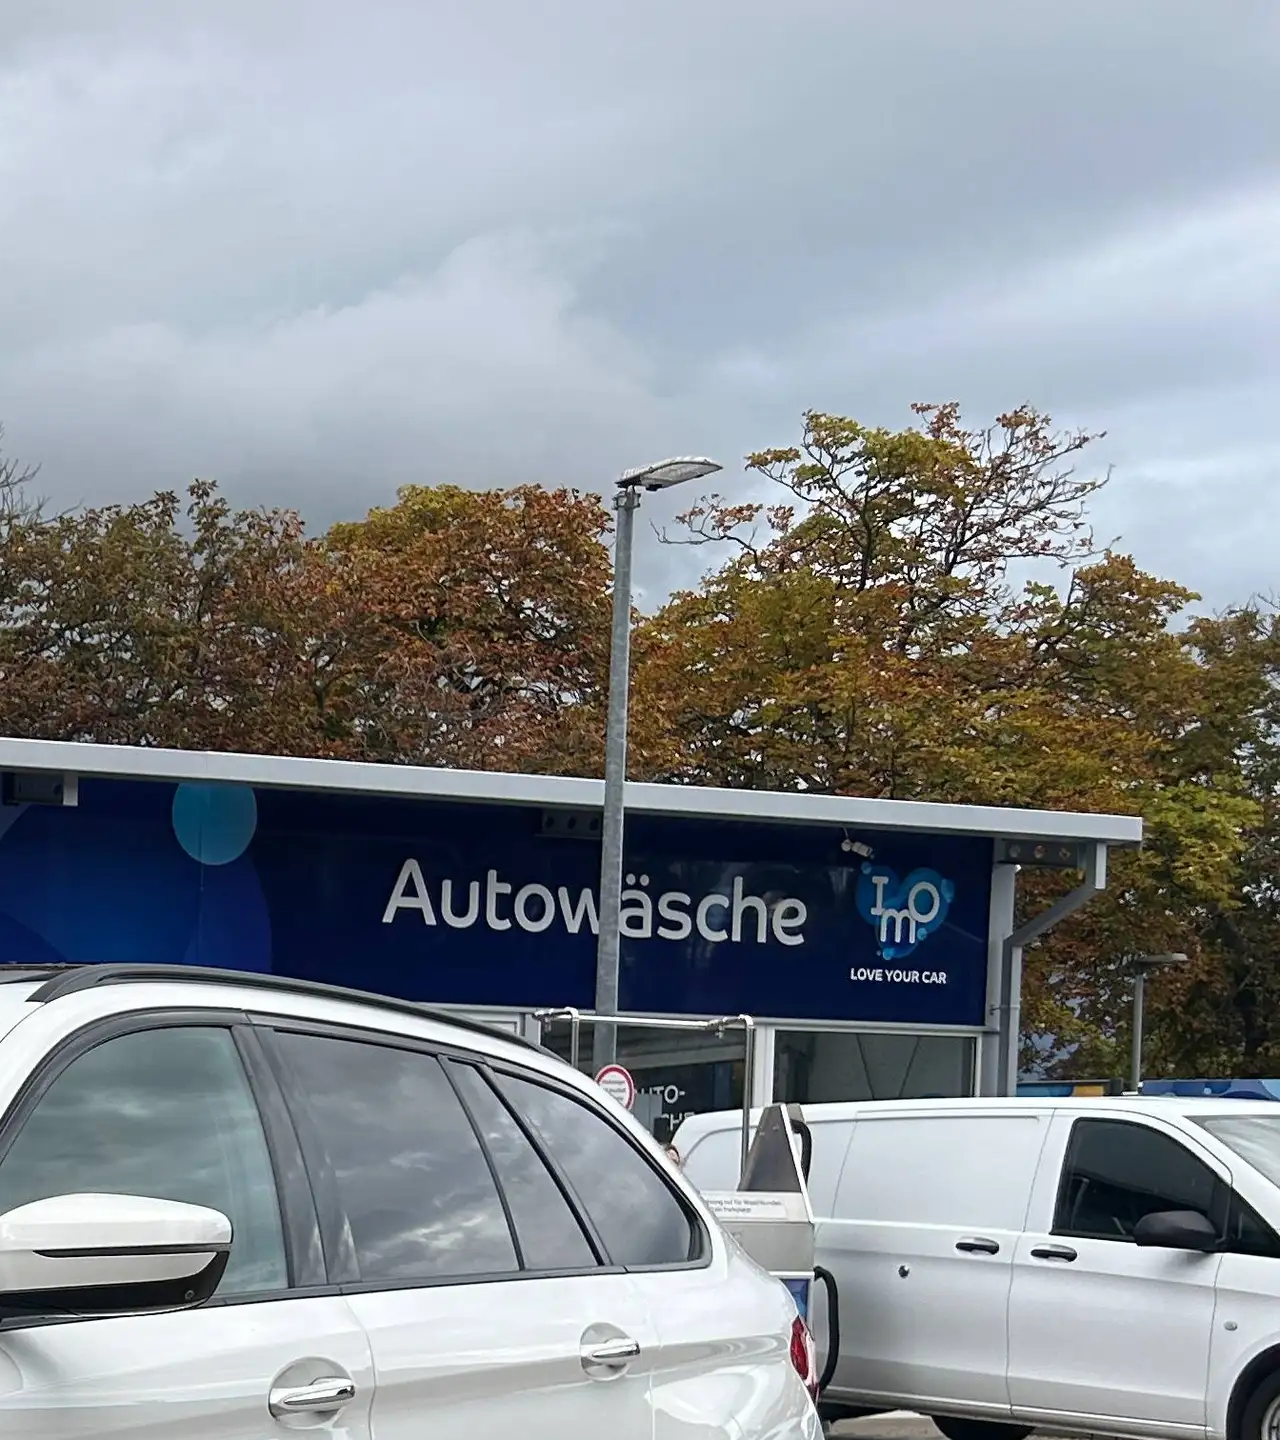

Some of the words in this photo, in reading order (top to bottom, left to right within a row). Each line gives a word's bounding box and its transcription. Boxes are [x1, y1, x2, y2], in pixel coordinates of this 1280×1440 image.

[382, 858, 807, 945] Autowäsche
[850, 967, 883, 982] LOVE
[885, 969, 920, 983] YOUR
[922, 971, 947, 984] CAR
